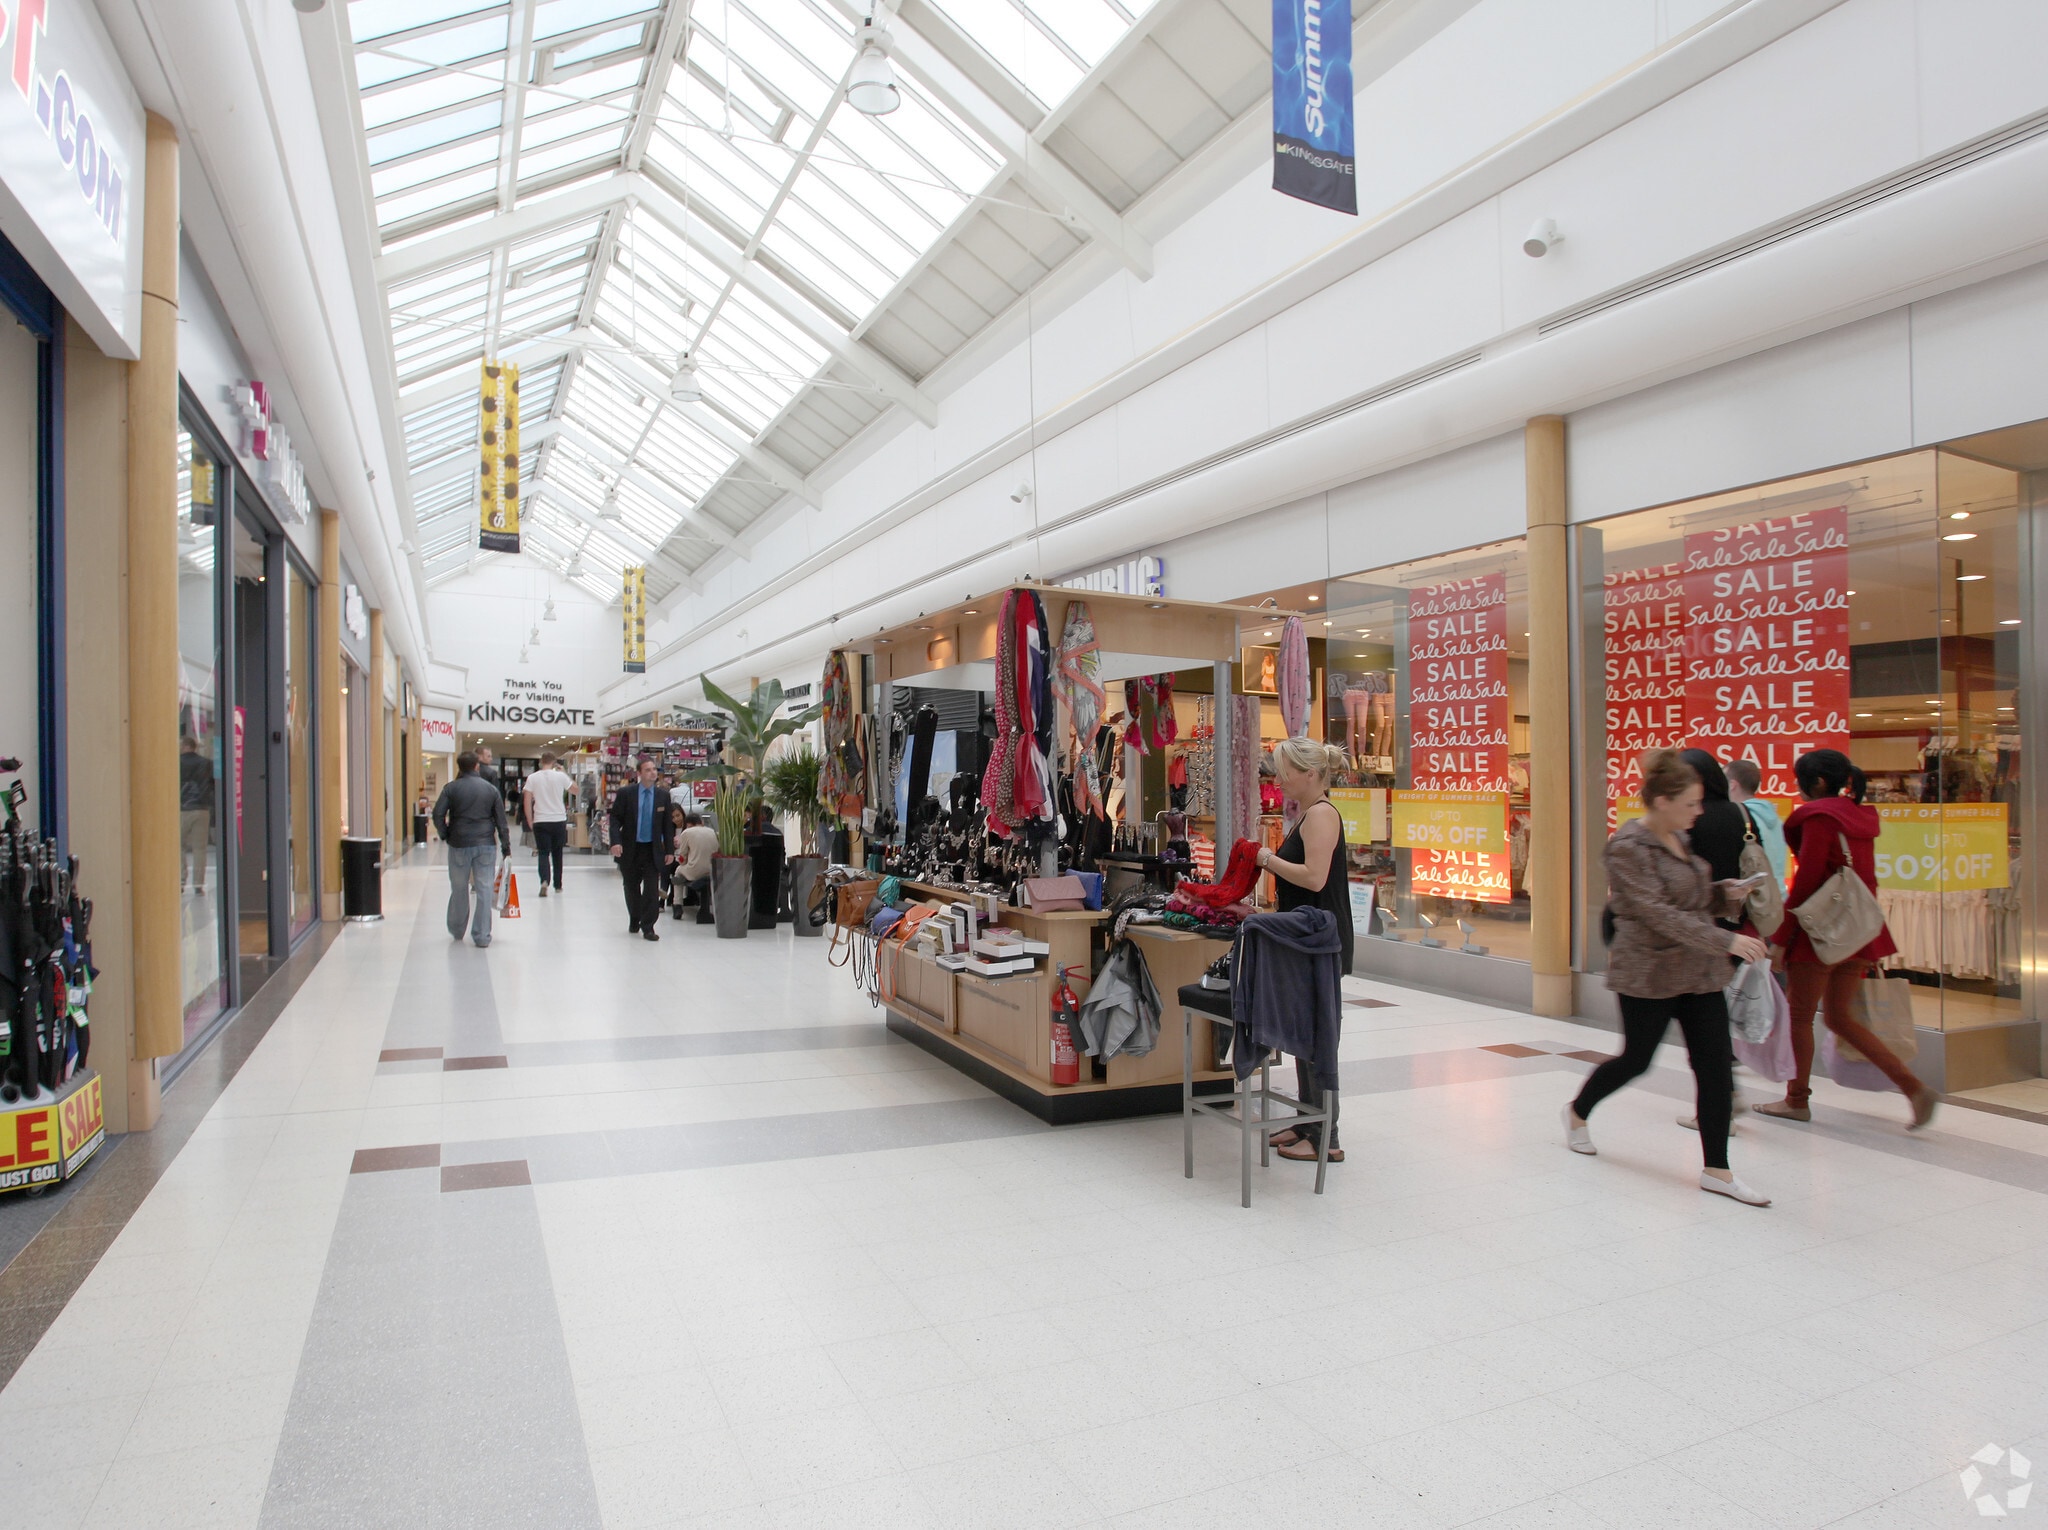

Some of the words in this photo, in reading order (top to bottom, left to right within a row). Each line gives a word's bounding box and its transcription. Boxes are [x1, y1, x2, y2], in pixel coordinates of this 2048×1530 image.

[0, 0, 122, 246] T.COM
[1285, 143, 1353, 175] KINGSGATE
[493, 375, 506, 454] collection
[493, 457, 506, 528] Summer
[1713, 560, 1814, 598] SALE
[1427, 612, 1487, 640] SALE
[1604, 602, 1681, 633] SALE
[1713, 619, 1814, 654] SALE
[1427, 657, 1487, 683] SALE
[1605, 653, 1682, 681] SALE
[502, 691, 519, 701] For
[526, 692, 565, 704] Visiting
[505, 679, 537, 689] Thank
[542, 680, 562, 690] You
[1715, 681, 1815, 712] SALE
[1427, 704, 1488, 728] SALE
[1606, 705, 1683, 730] SALE
[1429, 752, 1489, 773] SALE
[1428, 793, 1439, 801] OF
[1430, 810, 1445, 821] UP
[1447, 810, 1461, 822] TO
[1918, 809, 1940, 818] OF
[1945, 808, 1979, 818] SUMMER
[1981, 807, 2001, 817] SALE
[1407, 823, 1443, 843] 50%
[1448, 826, 1488, 846] OFF
[1924, 833, 1949, 849] UP
[1952, 833, 1968, 848] TO
[1430, 849, 1490, 867] SALE
[1875, 854, 1949, 881] 50%
[1954, 853, 1993, 880] OFF
[65, 1080, 102, 1151] SALE
[31, 1164, 57, 1182] GO!
